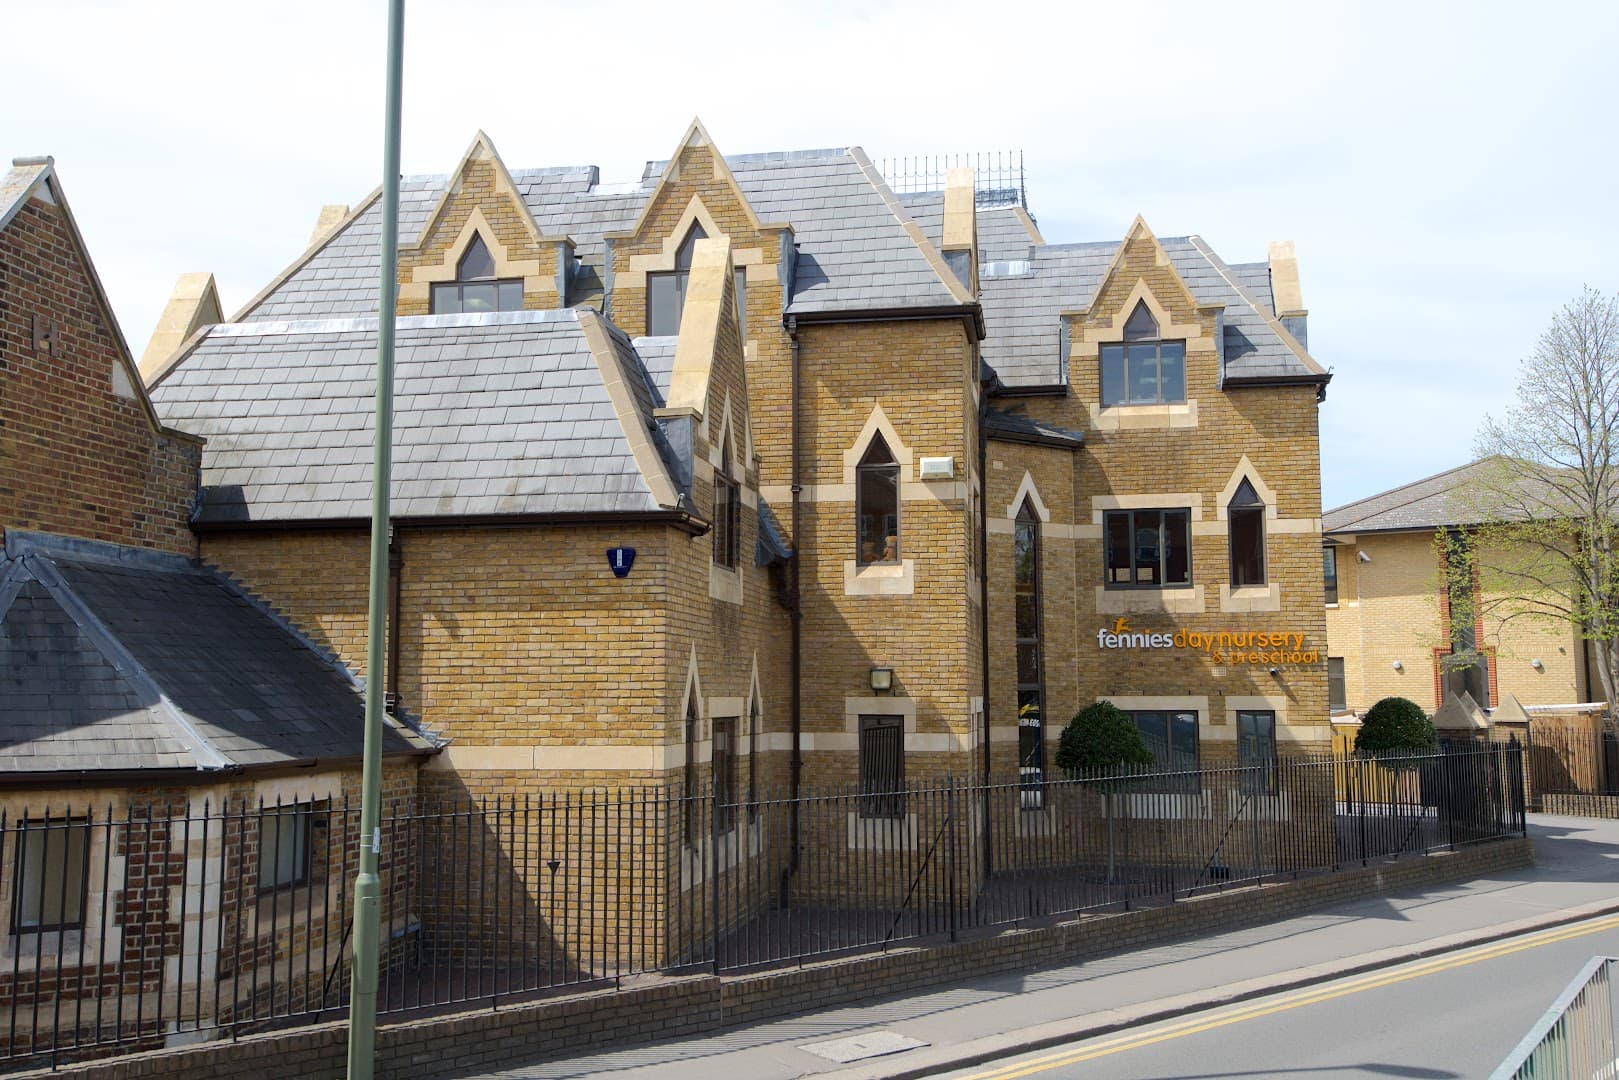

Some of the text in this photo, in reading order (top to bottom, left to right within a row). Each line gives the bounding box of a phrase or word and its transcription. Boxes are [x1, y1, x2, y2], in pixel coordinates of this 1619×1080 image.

[1097, 627, 1305, 653] fennies day nursery
[1212, 648, 1318, 667] & preschool
